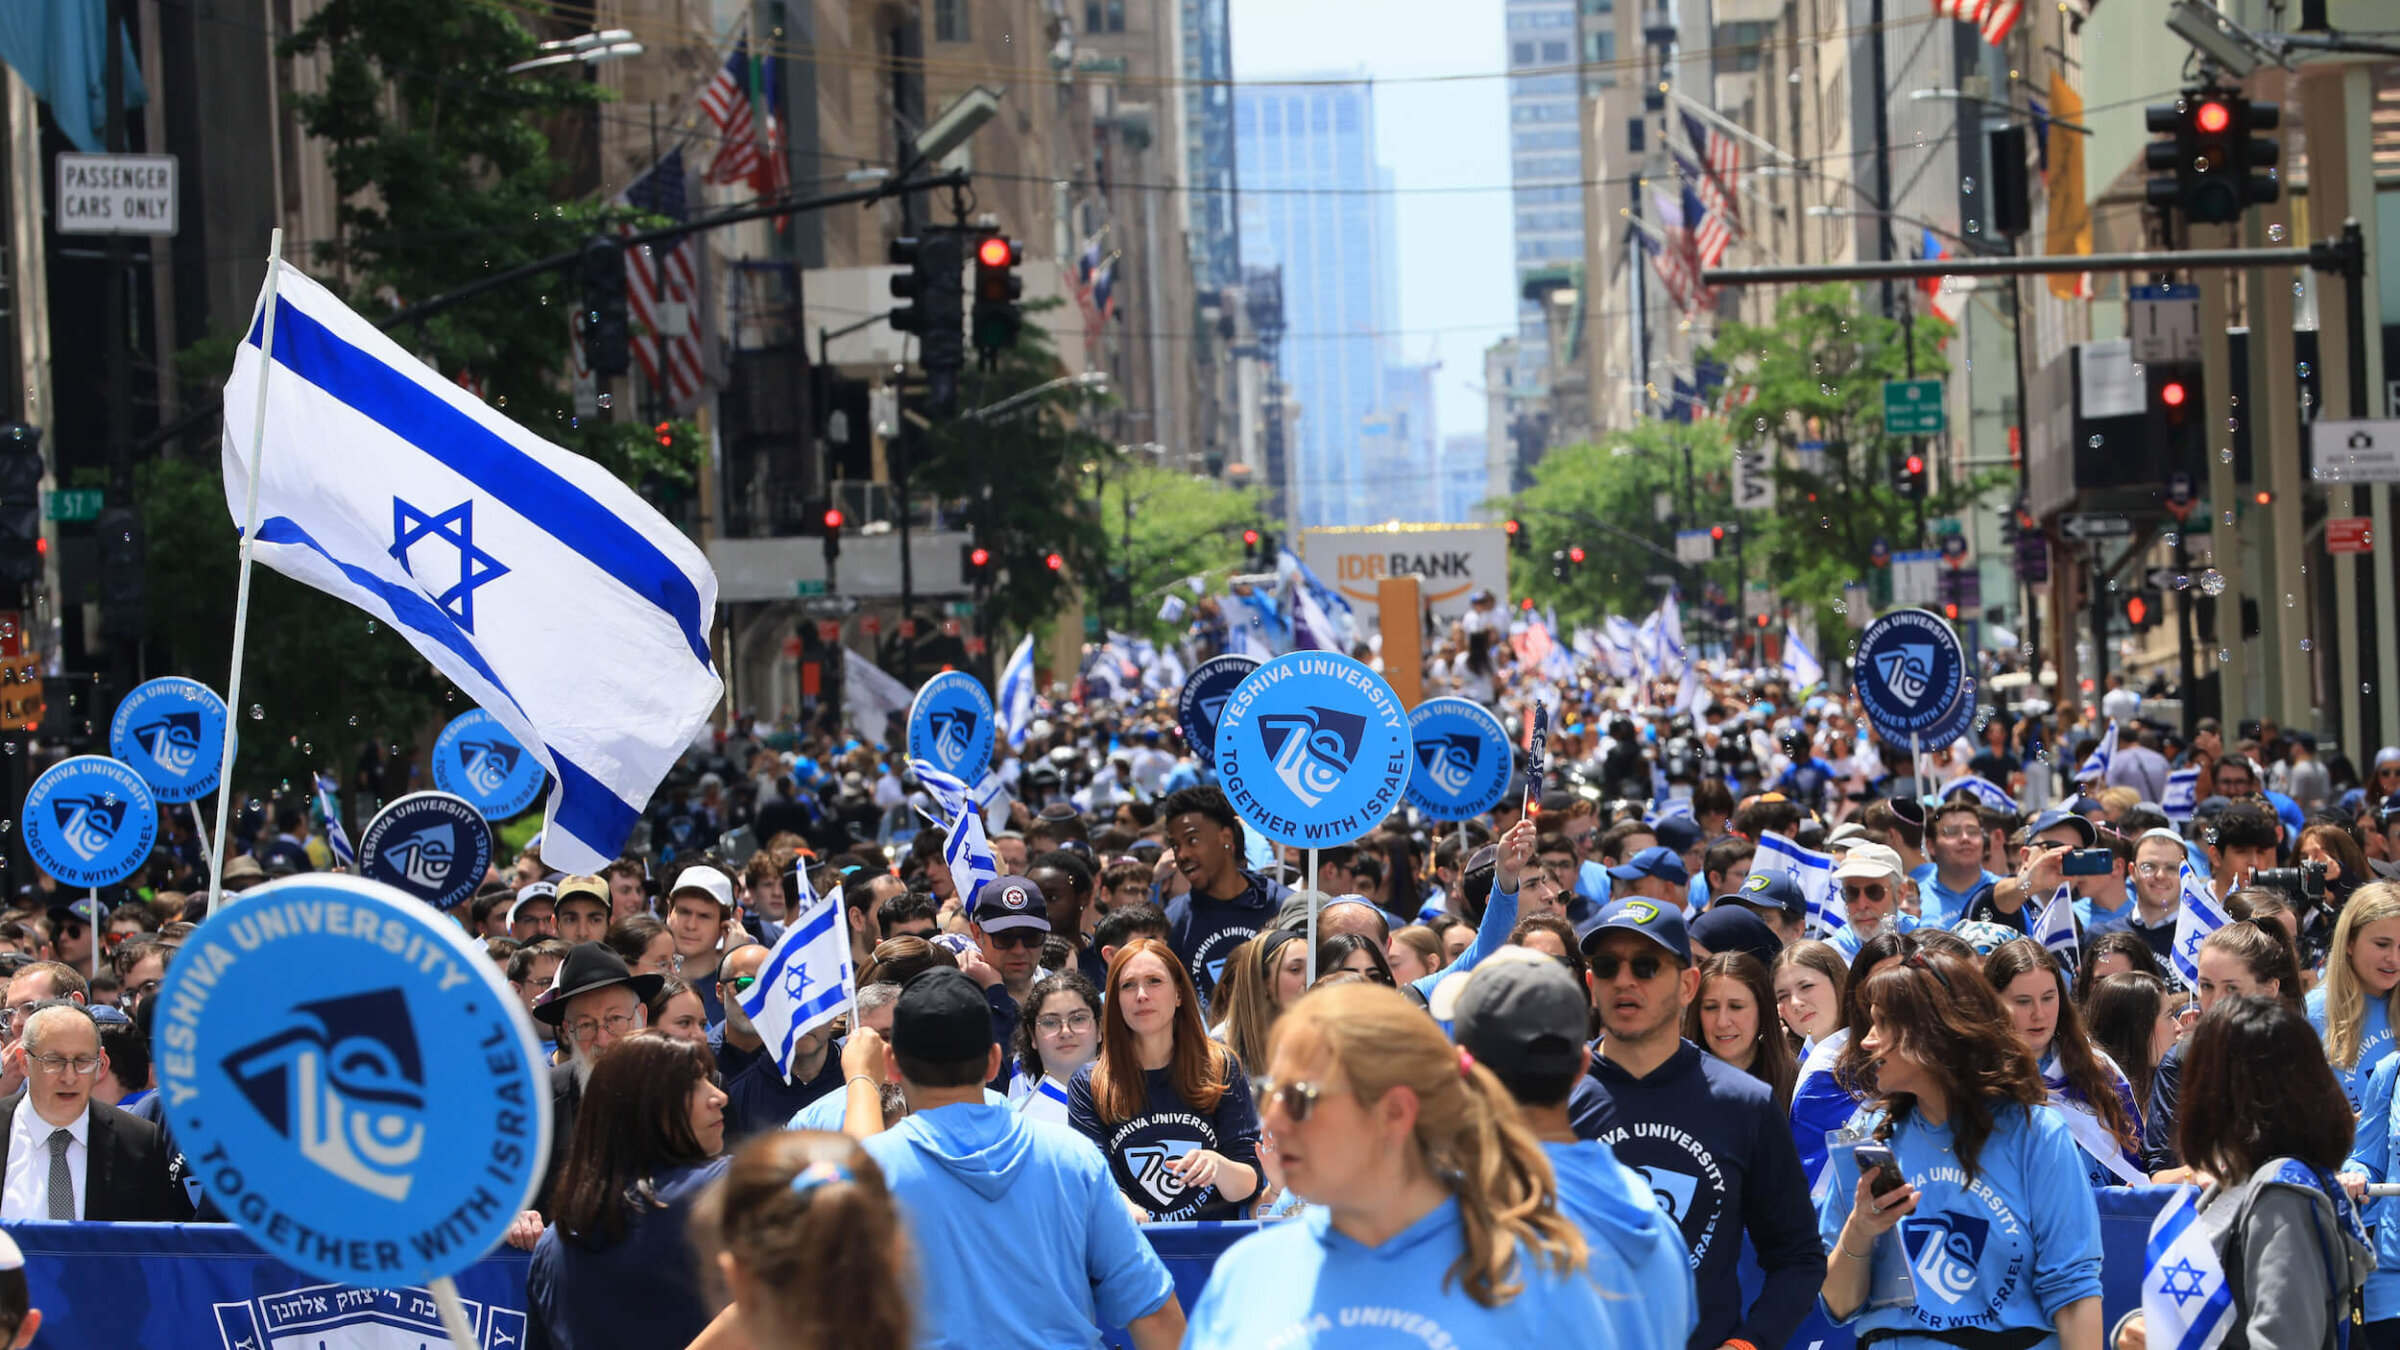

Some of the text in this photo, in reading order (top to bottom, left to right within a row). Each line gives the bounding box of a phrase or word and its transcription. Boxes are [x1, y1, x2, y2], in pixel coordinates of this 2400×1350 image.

[66, 165, 168, 190] PASSENGER
[65, 195, 168, 219] CARS ONLY
[1857, 614, 1954, 667] YESHIVA UNIVERSITY
[914, 677, 992, 721] YESHIVA UNIVERSITY
[1181, 667, 1214, 712] YESHIVA
[1223, 660, 1401, 728] YESHIVA UNIVERSITY
[1859, 661, 1959, 728] TOGETHER WITH ISRAEL
[113, 693, 146, 744] YESHIVA
[1433, 703, 1502, 742] UNIVERSITY
[29, 762, 151, 811] YESHIVA UNIVERSITY
[183, 773, 216, 796] WITH
[1222, 749, 1405, 839] TOGETHER WITH ISRAEL
[1453, 799, 1486, 817] WITH
[1486, 755, 1508, 801] ISRAEL
[27, 820, 153, 882] TOGETHER WITH ISRAEL
[363, 799, 476, 869] YESHIVA UNIVERSITY
[439, 829, 488, 907] WITH ISRAEL
[1192, 926, 1257, 975] YESHIVA UNIVE
[164, 901, 471, 1107] YESHIVA UNIVERSITY
[202, 1020, 528, 1273] TOGETHER WITH ISRAEL
[1110, 1117, 1150, 1154] ESHIVA
[1634, 1123, 1725, 1192] UNIVERSITY
[1160, 1206, 1196, 1222] WITH
[1689, 1211, 1721, 1269] SRAEL
[271, 1295, 328, 1323] אלחנן
[1947, 1306, 1994, 1328] WITH
[1991, 1254, 2023, 1317] ISRAEL
